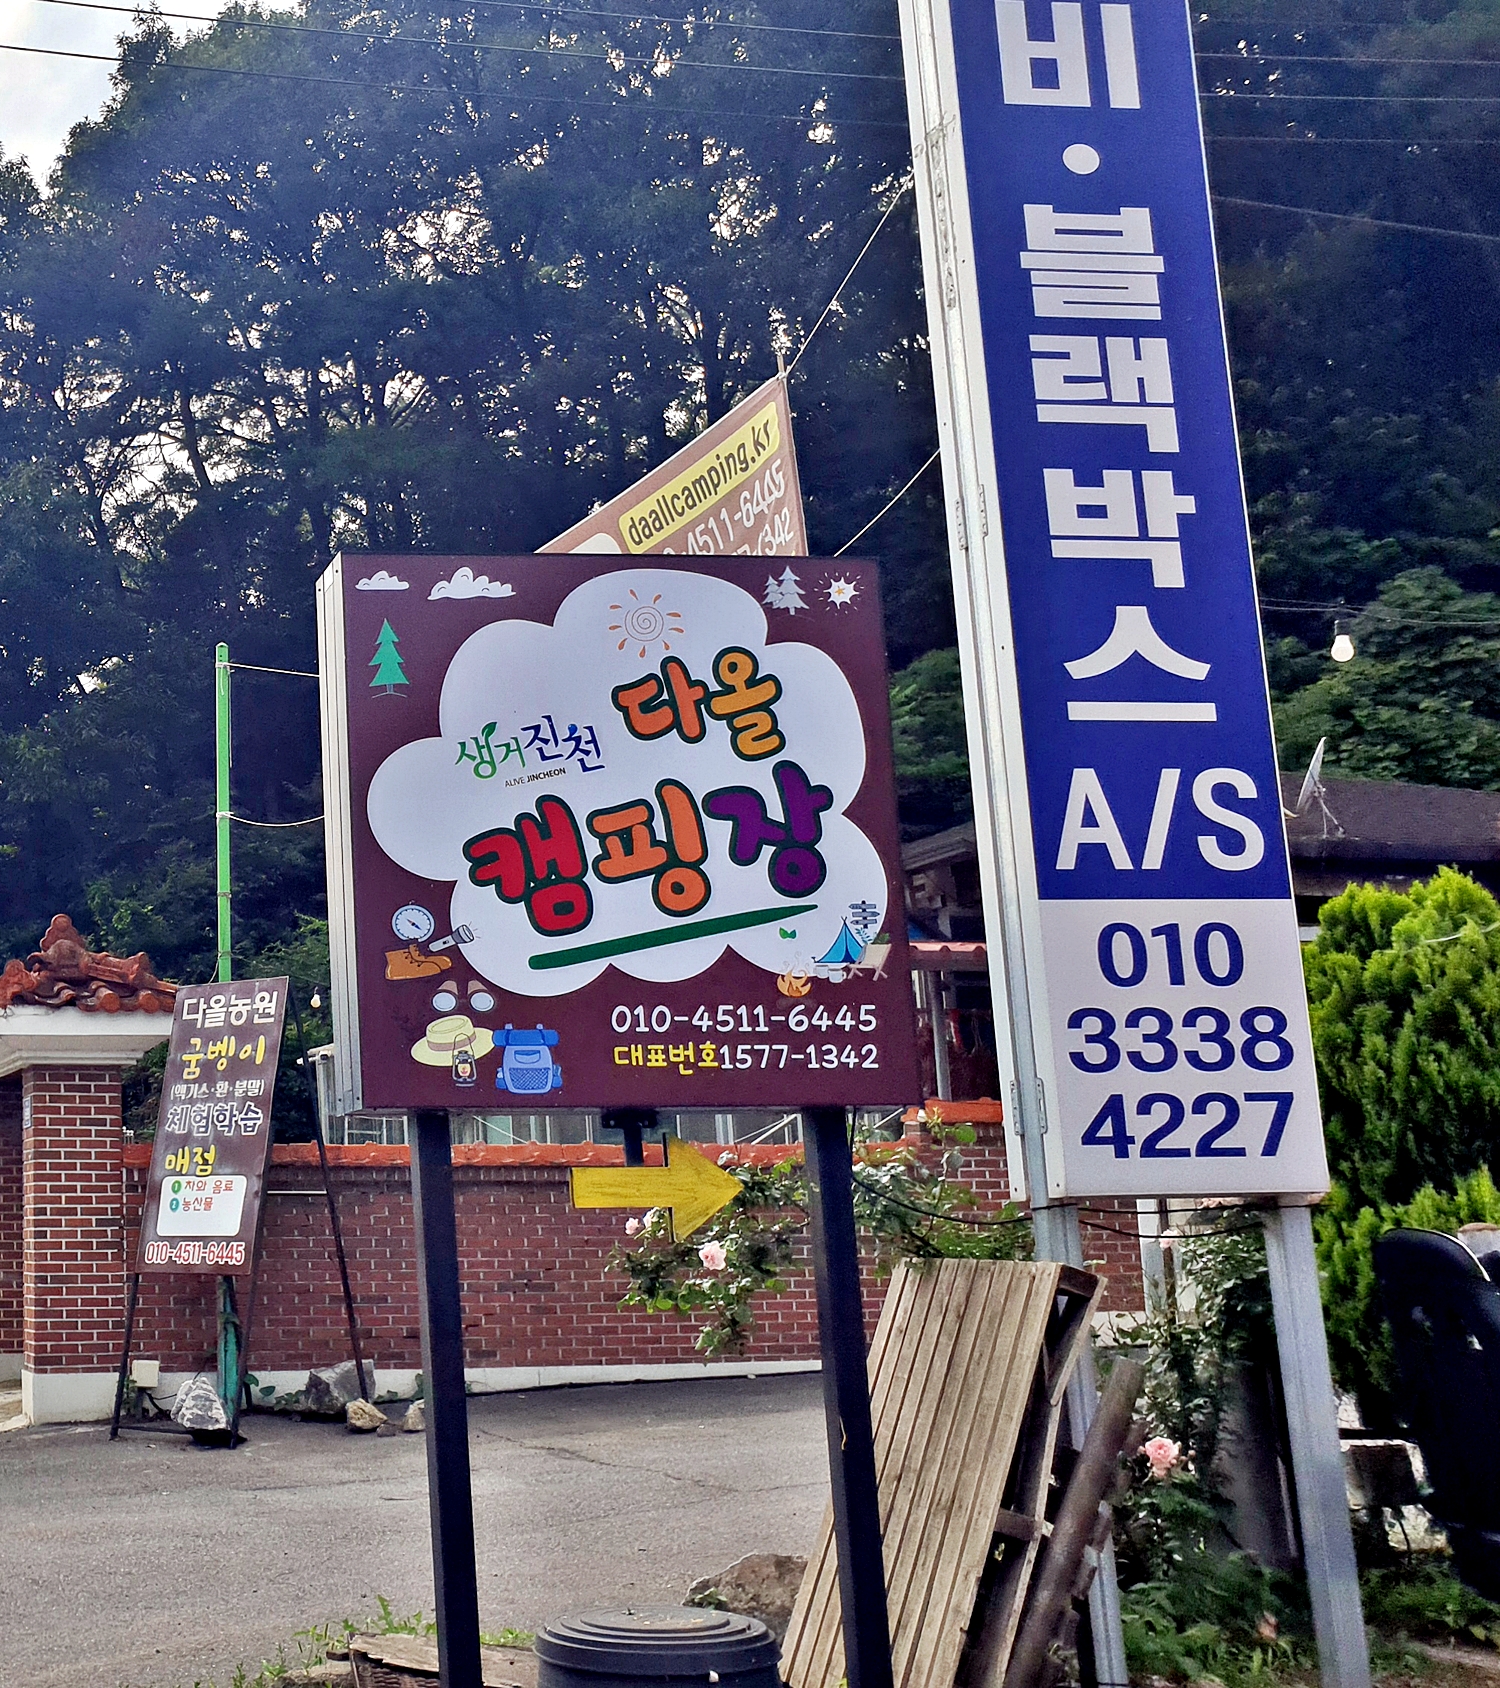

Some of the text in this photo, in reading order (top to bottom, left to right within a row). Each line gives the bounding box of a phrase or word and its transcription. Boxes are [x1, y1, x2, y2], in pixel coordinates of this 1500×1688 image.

[628, 418, 771, 546] daallcamping.kr
[611, 646, 784, 761] 다올
[505, 767, 566, 787] ALIVE JINCHEON
[1056, 768, 1264, 871] A/S
[463, 759, 834, 936] 캠핑장
[1097, 922, 1244, 988] 010
[182, 991, 278, 1029] 다올농원
[611, 1004, 877, 1033] 010-4511-6445
[182, 1035, 266, 1080] 굼벵이
[1067, 1006, 1295, 1074] 3338
[165, 1101, 263, 1136] 체험학습
[1080, 1091, 1295, 1159] 4227
[165, 1145, 216, 1176] 매점
[182, 1197, 213, 1212] 농산물
[212, 1180, 234, 1194] 음료
[145, 1241, 245, 1264] 010-4511-6445
